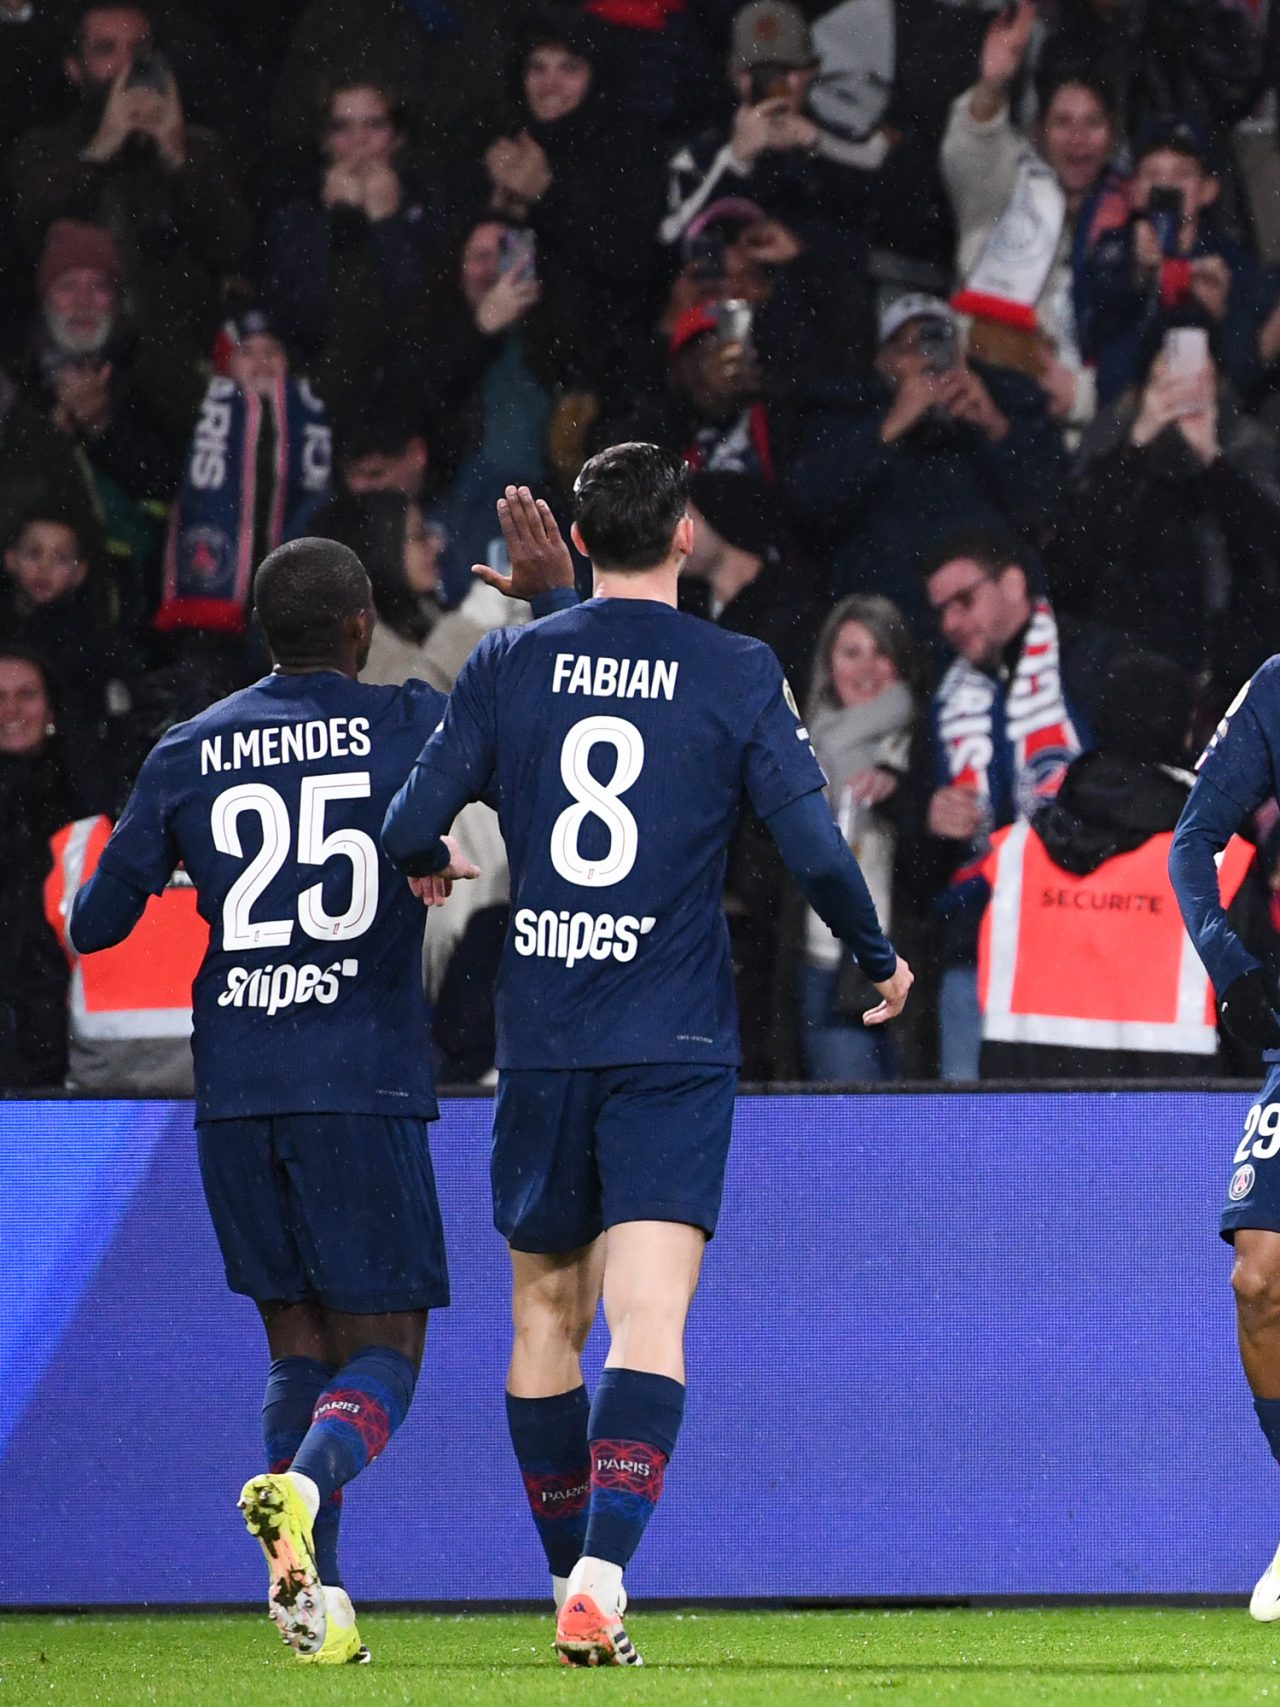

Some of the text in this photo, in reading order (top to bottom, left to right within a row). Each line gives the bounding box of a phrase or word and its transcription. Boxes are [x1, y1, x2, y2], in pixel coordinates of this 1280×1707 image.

[552, 653, 679, 700] FABIAN
[201, 716, 371, 776] N.MENDES
[551, 715, 645, 887] 8
[210, 771, 379, 952] 25
[597, 1459, 650, 1477] PARIS
